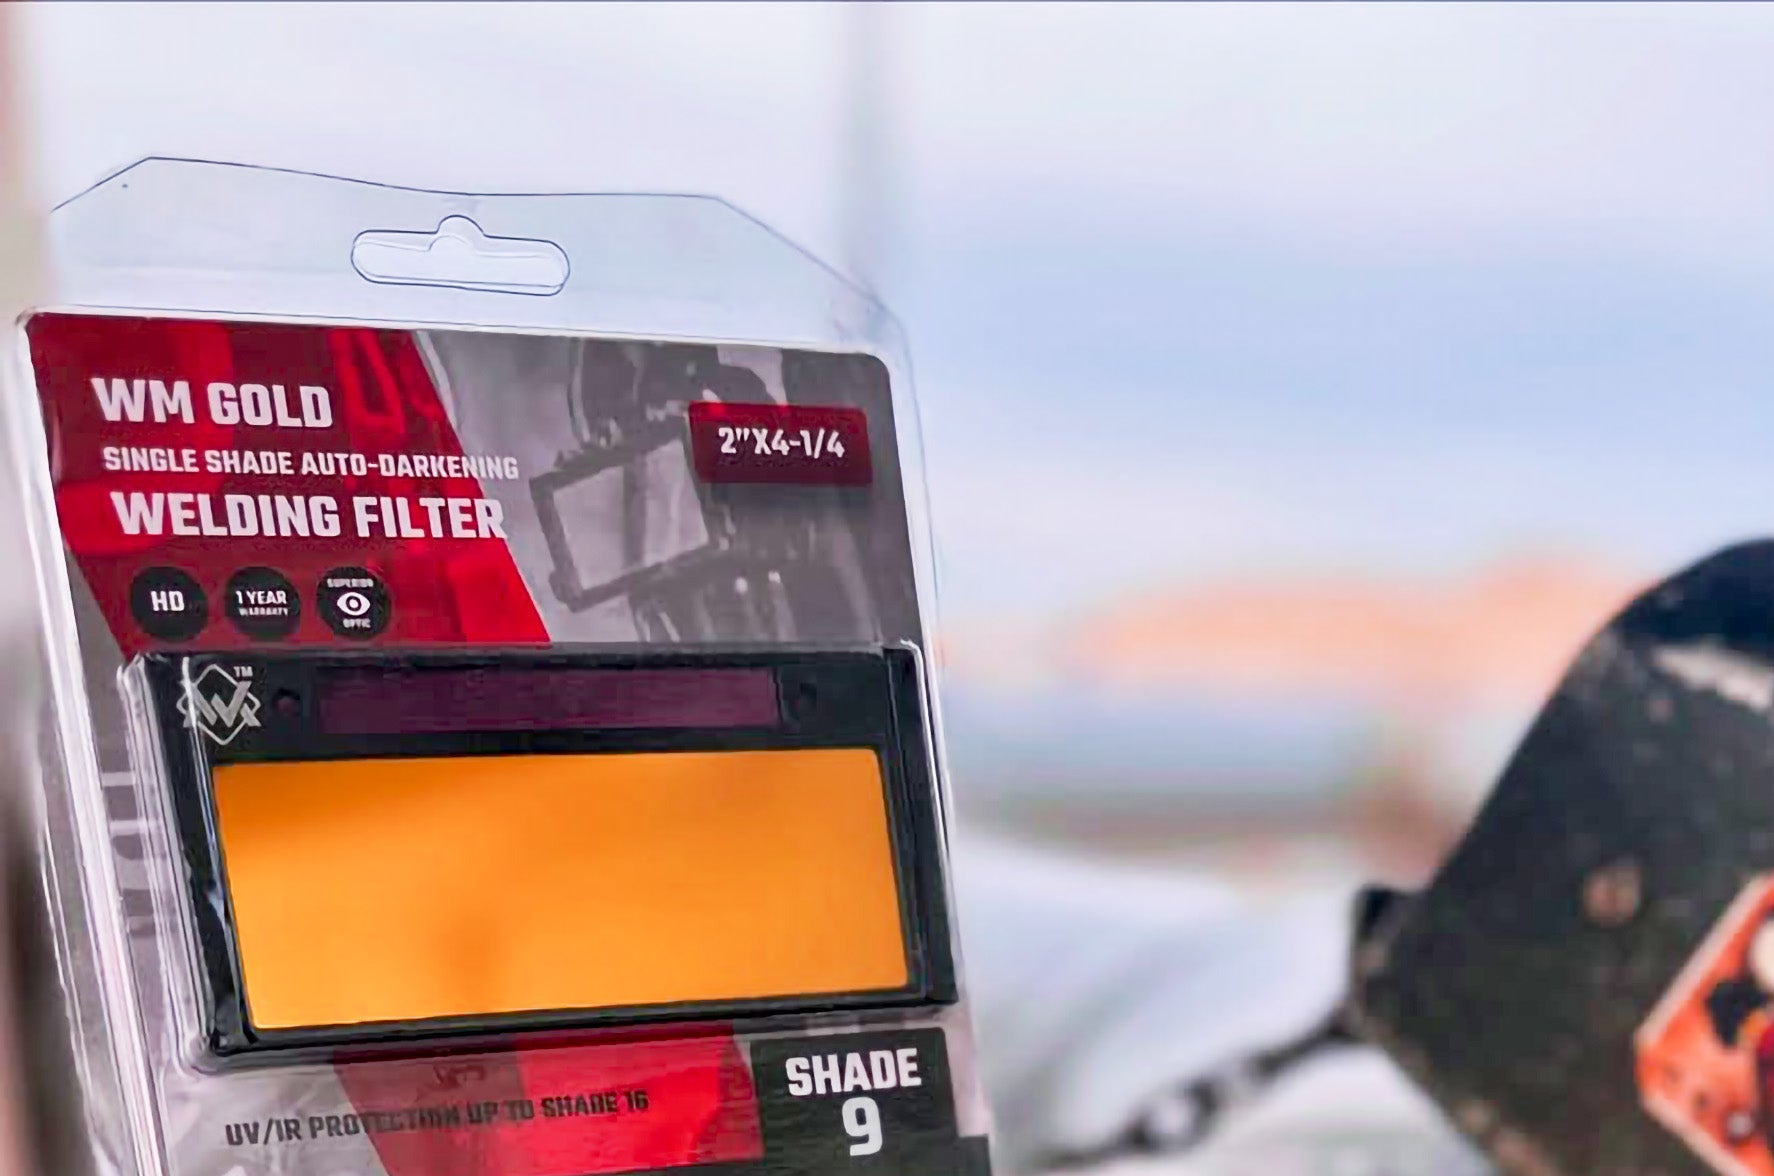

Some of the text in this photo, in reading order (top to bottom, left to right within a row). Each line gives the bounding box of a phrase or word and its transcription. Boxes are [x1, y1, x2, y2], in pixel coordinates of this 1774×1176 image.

[91, 377, 333, 428] WM GOLD
[104, 446, 519, 480] SINGLE SHADE AUTO-DARKENING
[110, 491, 508, 539] WELDING FILTER
[151, 590, 185, 612] HD
[236, 590, 287, 605] 1 YEAR
[233, 666, 253, 677] TM
[785, 1048, 922, 1096] SHADE
[226, 1090, 650, 1146] UV/IR PROTECTION UP TO SHADE 16
[841, 1096, 883, 1157] 9
